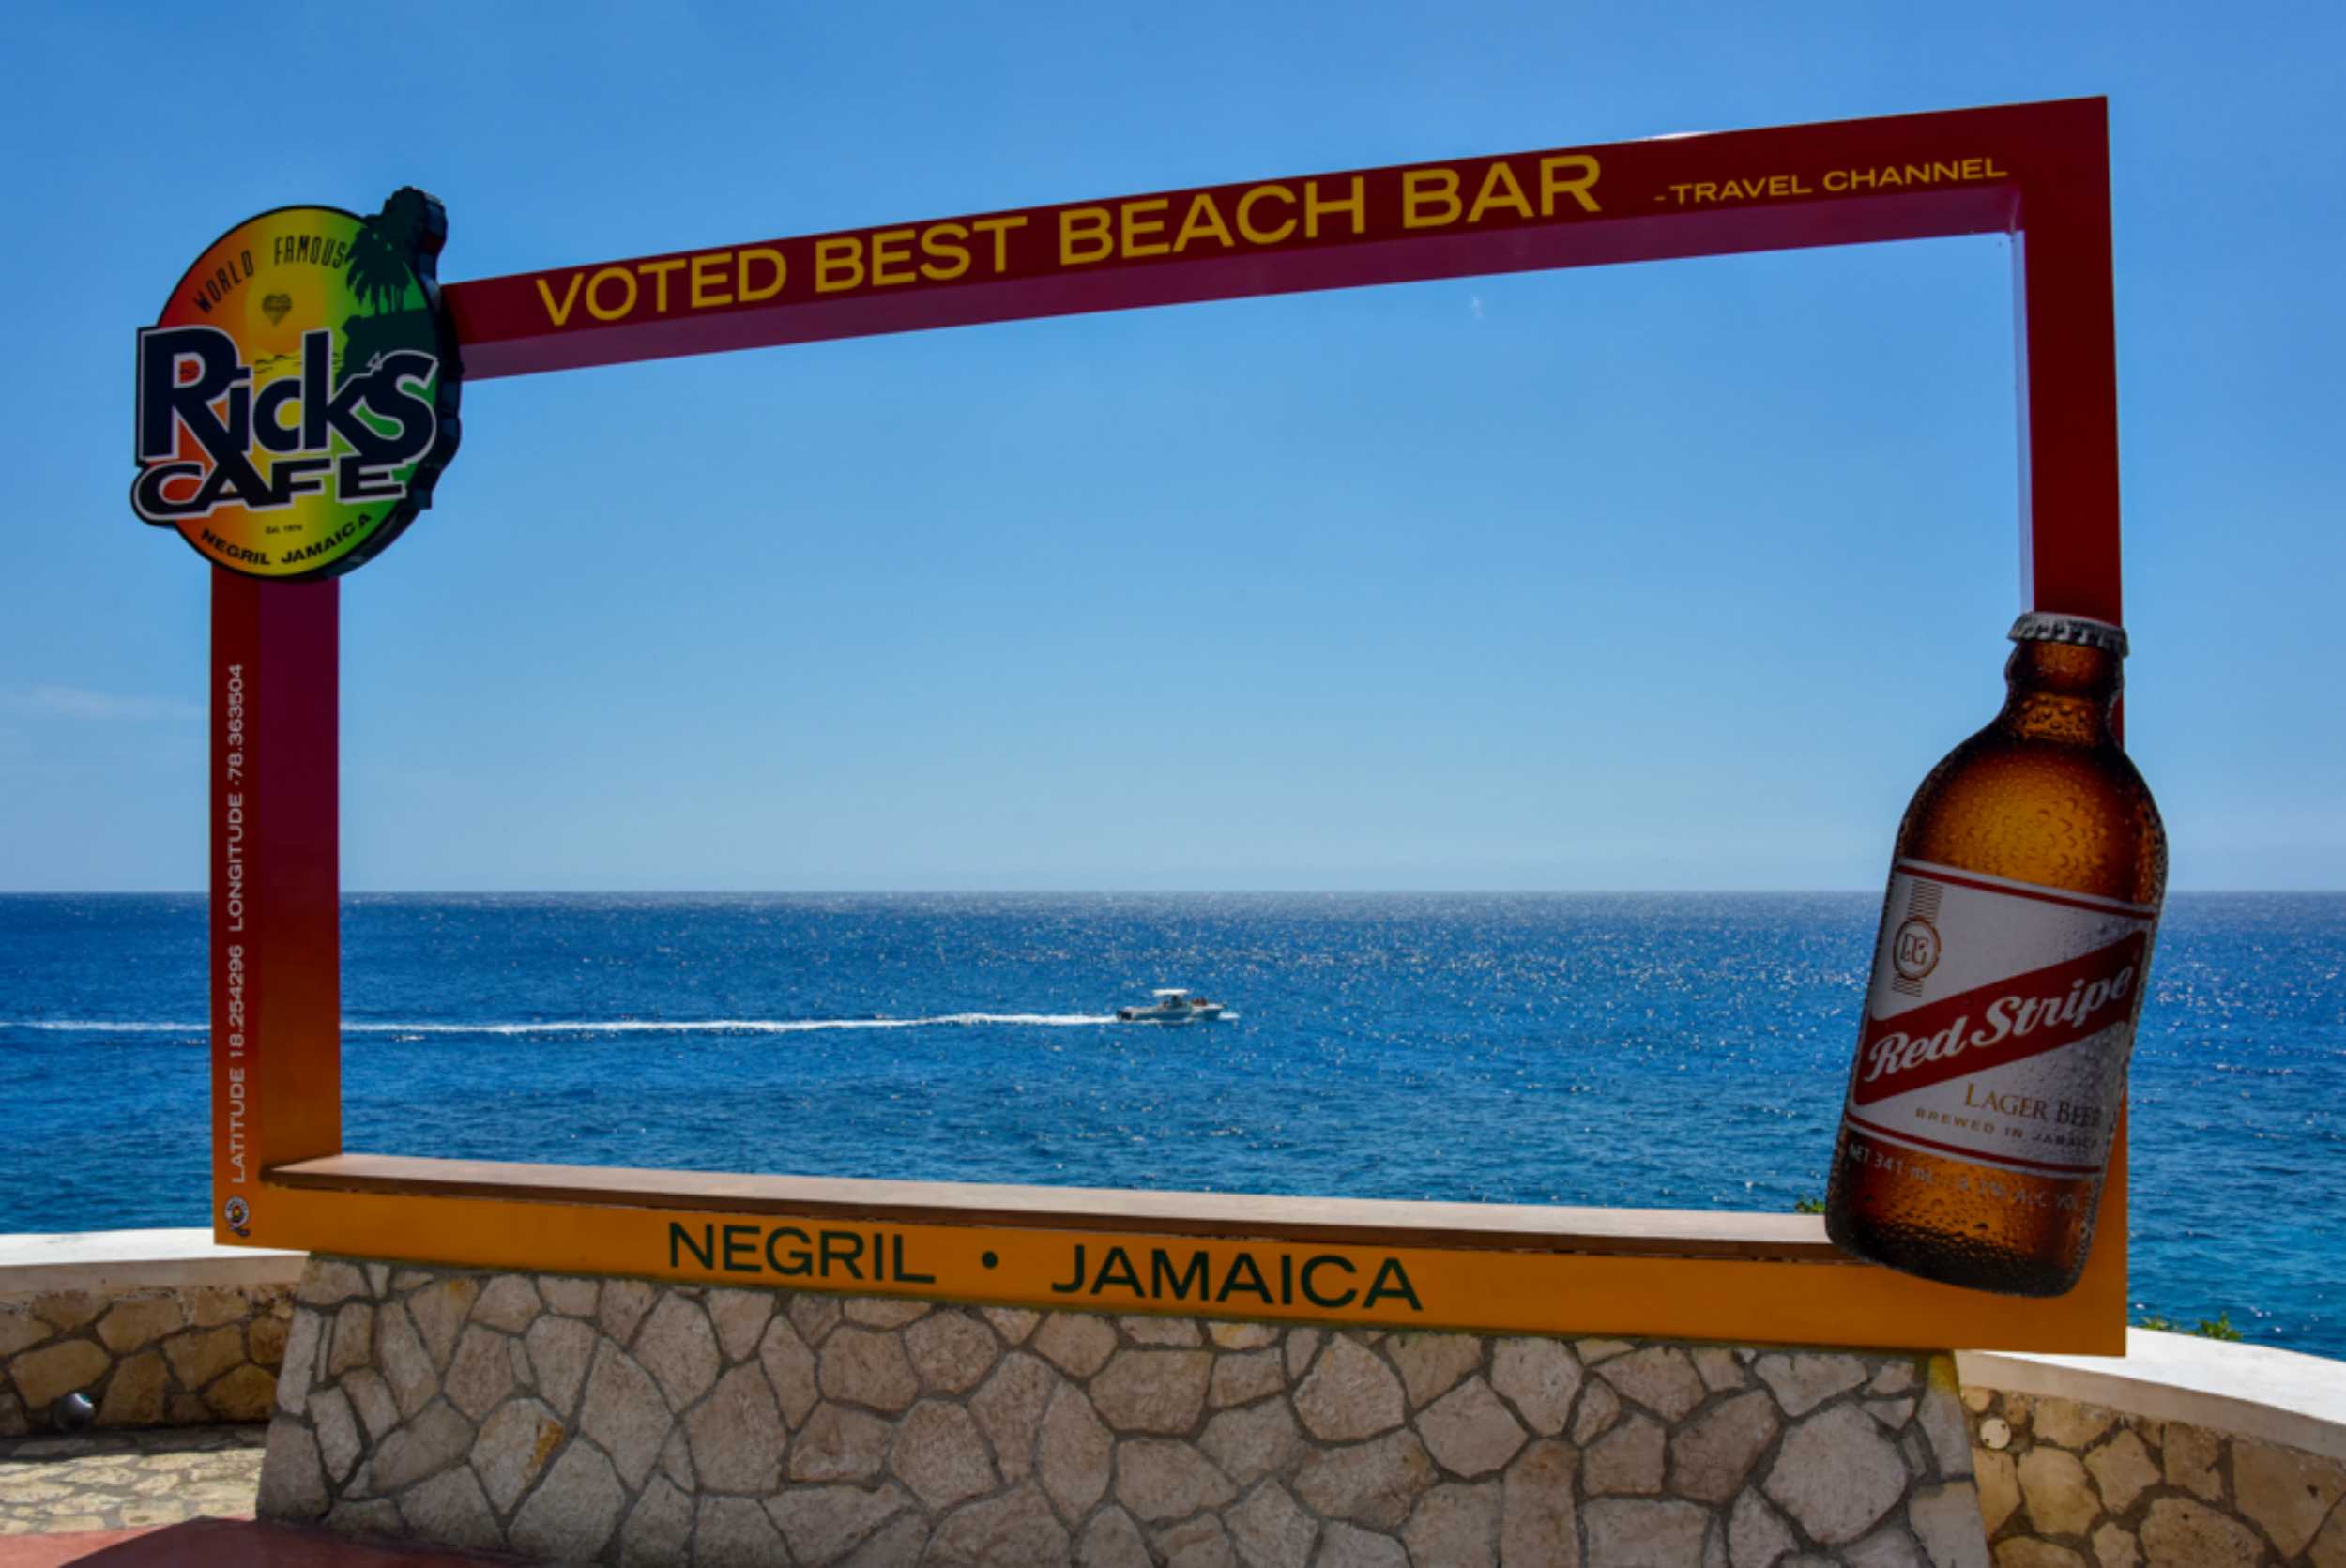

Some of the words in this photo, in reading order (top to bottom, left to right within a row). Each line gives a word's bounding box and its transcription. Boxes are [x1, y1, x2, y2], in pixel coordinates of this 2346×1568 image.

[1821, 156, 2009, 192] CHANNEL
[193, 250, 254, 314] WORLD
[273, 235, 347, 269] FAMOUS
[536, 248, 787, 327] VOTED
[815, 215, 1028, 293] BEST
[1059, 175, 1365, 266] BEACH
[1401, 153, 1602, 230] BAR
[130, 458, 408, 522] CAFE
[200, 528, 271, 566] NEGRIL
[282, 512, 373, 564] JAMAICA
[227, 793, 244, 932] LONGITUDE
[227, 945, 245, 1058] 18.254296
[1864, 1014, 1968, 1083] Red
[1970, 965, 2133, 1047] Stripe
[228, 1068, 245, 1183] LATITUDE
[1915, 1106, 1996, 1134] BREWED
[2003, 1126, 2023, 1139] IN
[1964, 1082, 2049, 1124] LAGER
[668, 1221, 937, 1286] NEGRIL
[1050, 1243, 1423, 1311] JAMAICA
